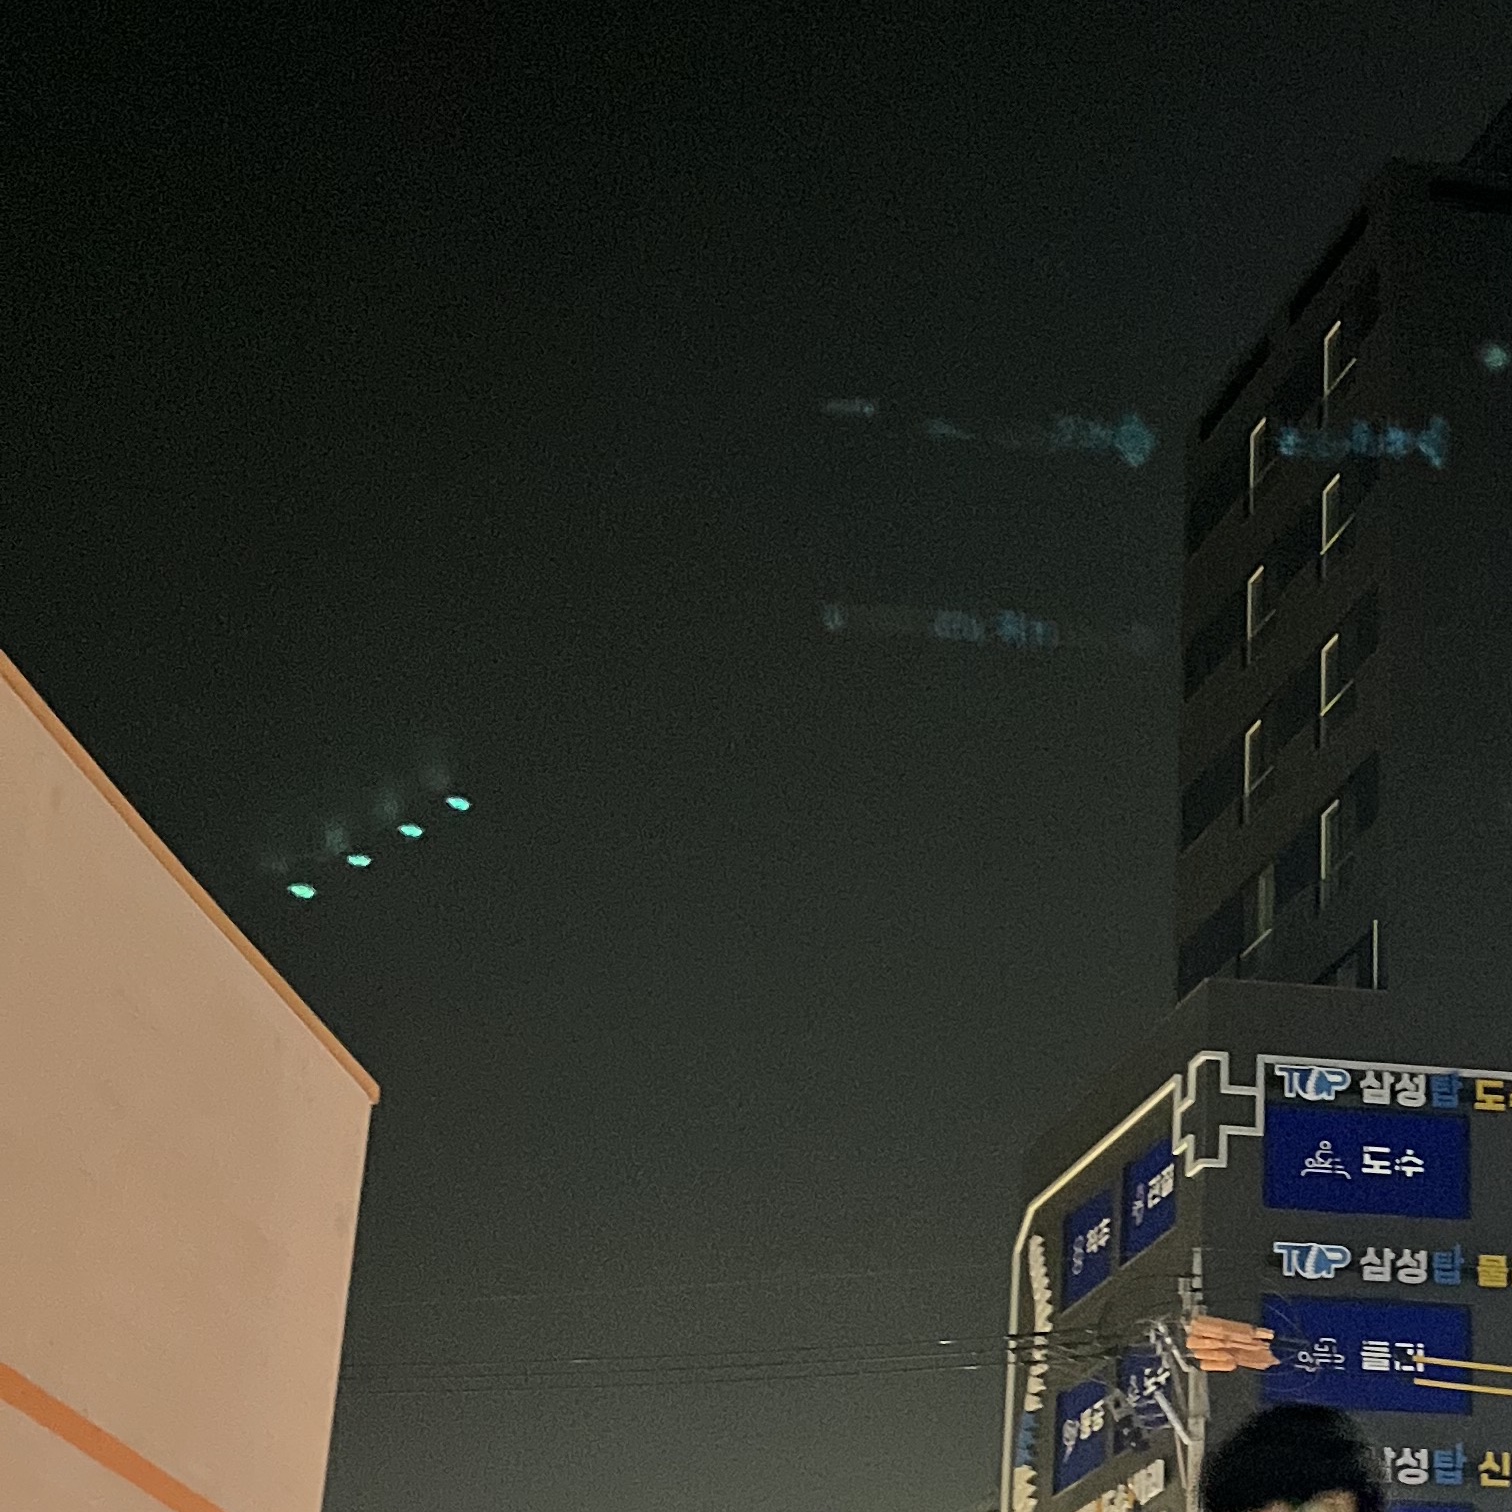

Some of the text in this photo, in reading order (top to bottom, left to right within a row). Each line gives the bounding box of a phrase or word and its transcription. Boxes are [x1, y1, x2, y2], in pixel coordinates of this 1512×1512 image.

[1274, 1065, 1351, 1101] TOP
[1359, 1069, 1462, 1108] 삼성탑
[1360, 1145, 1425, 1178] 도수
[1273, 1241, 1352, 1280] TOP
[1359, 1244, 1464, 1286] 삼성탑
